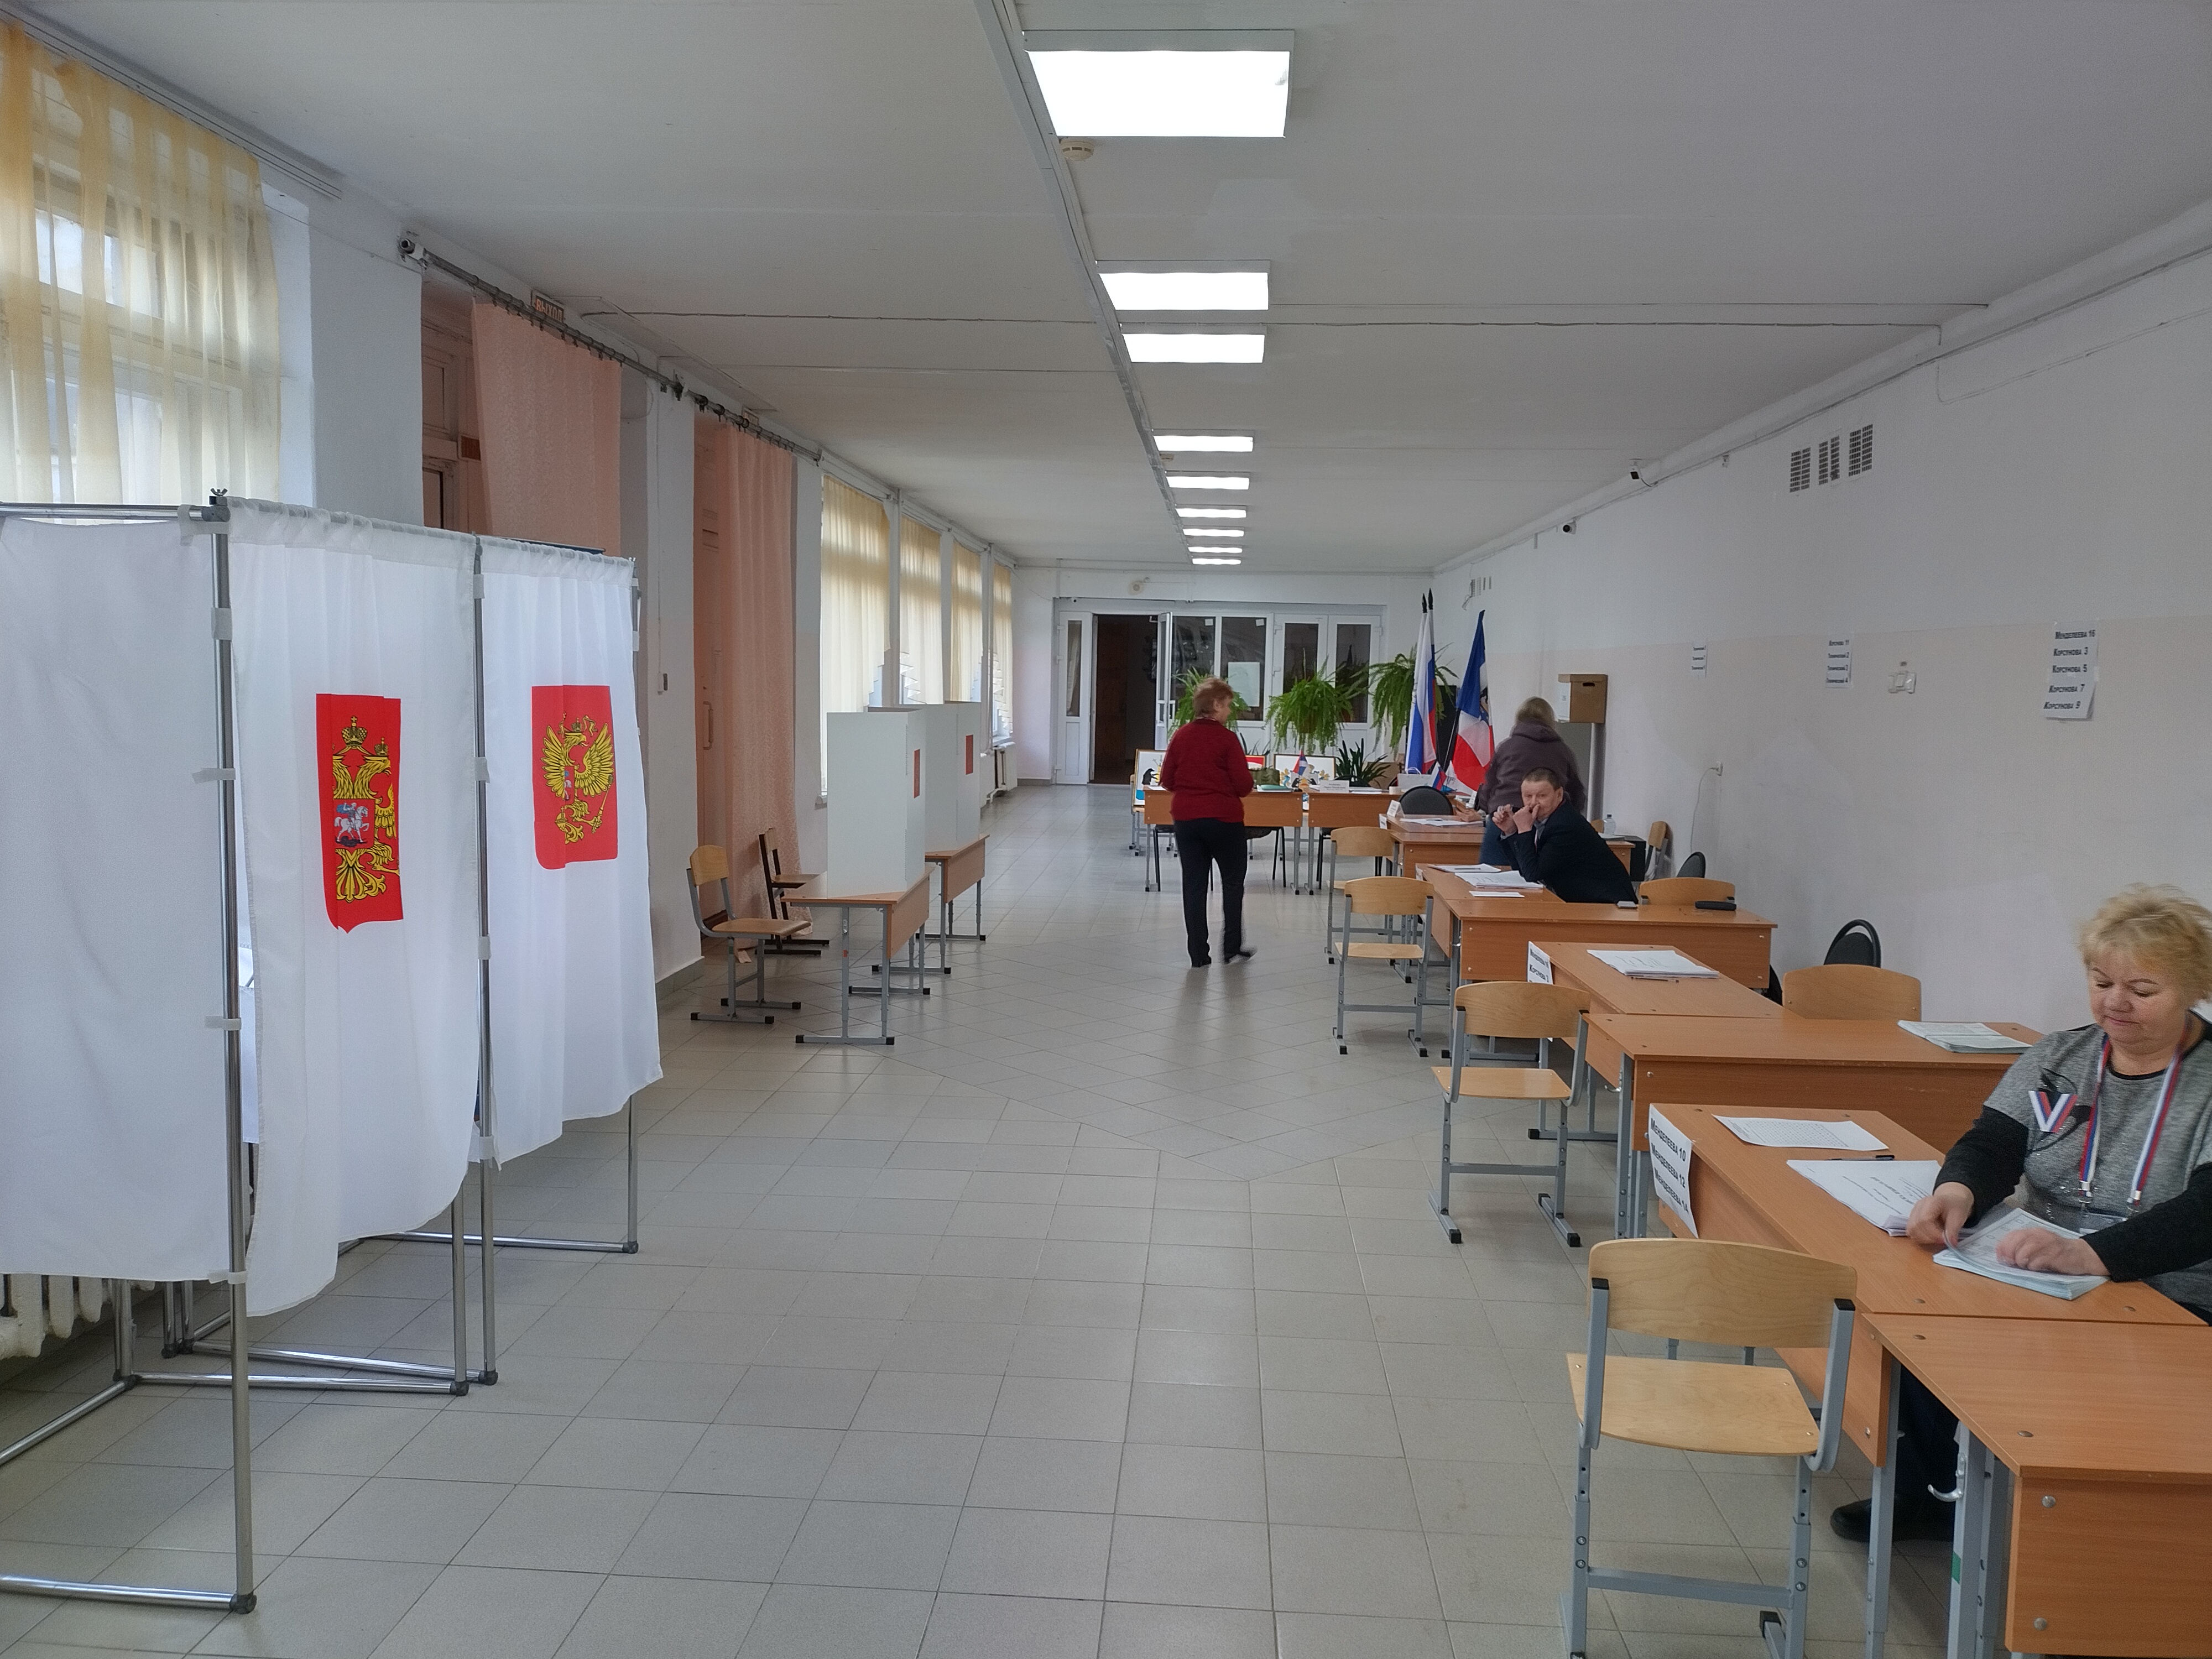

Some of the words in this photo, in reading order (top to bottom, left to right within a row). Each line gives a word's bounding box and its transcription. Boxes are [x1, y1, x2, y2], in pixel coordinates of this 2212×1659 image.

[536, 299, 562, 322] ВЫХОД
[2084, 646, 2089, 655] 3
[2083, 664, 2088, 672] 5
[2075, 701, 2081, 709] 9
[1651, 1118, 1678, 1156] МЕНДЕЛЕЕВА
[1679, 1147, 1686, 1162] 10
[1679, 1173, 1686, 1189] 12
